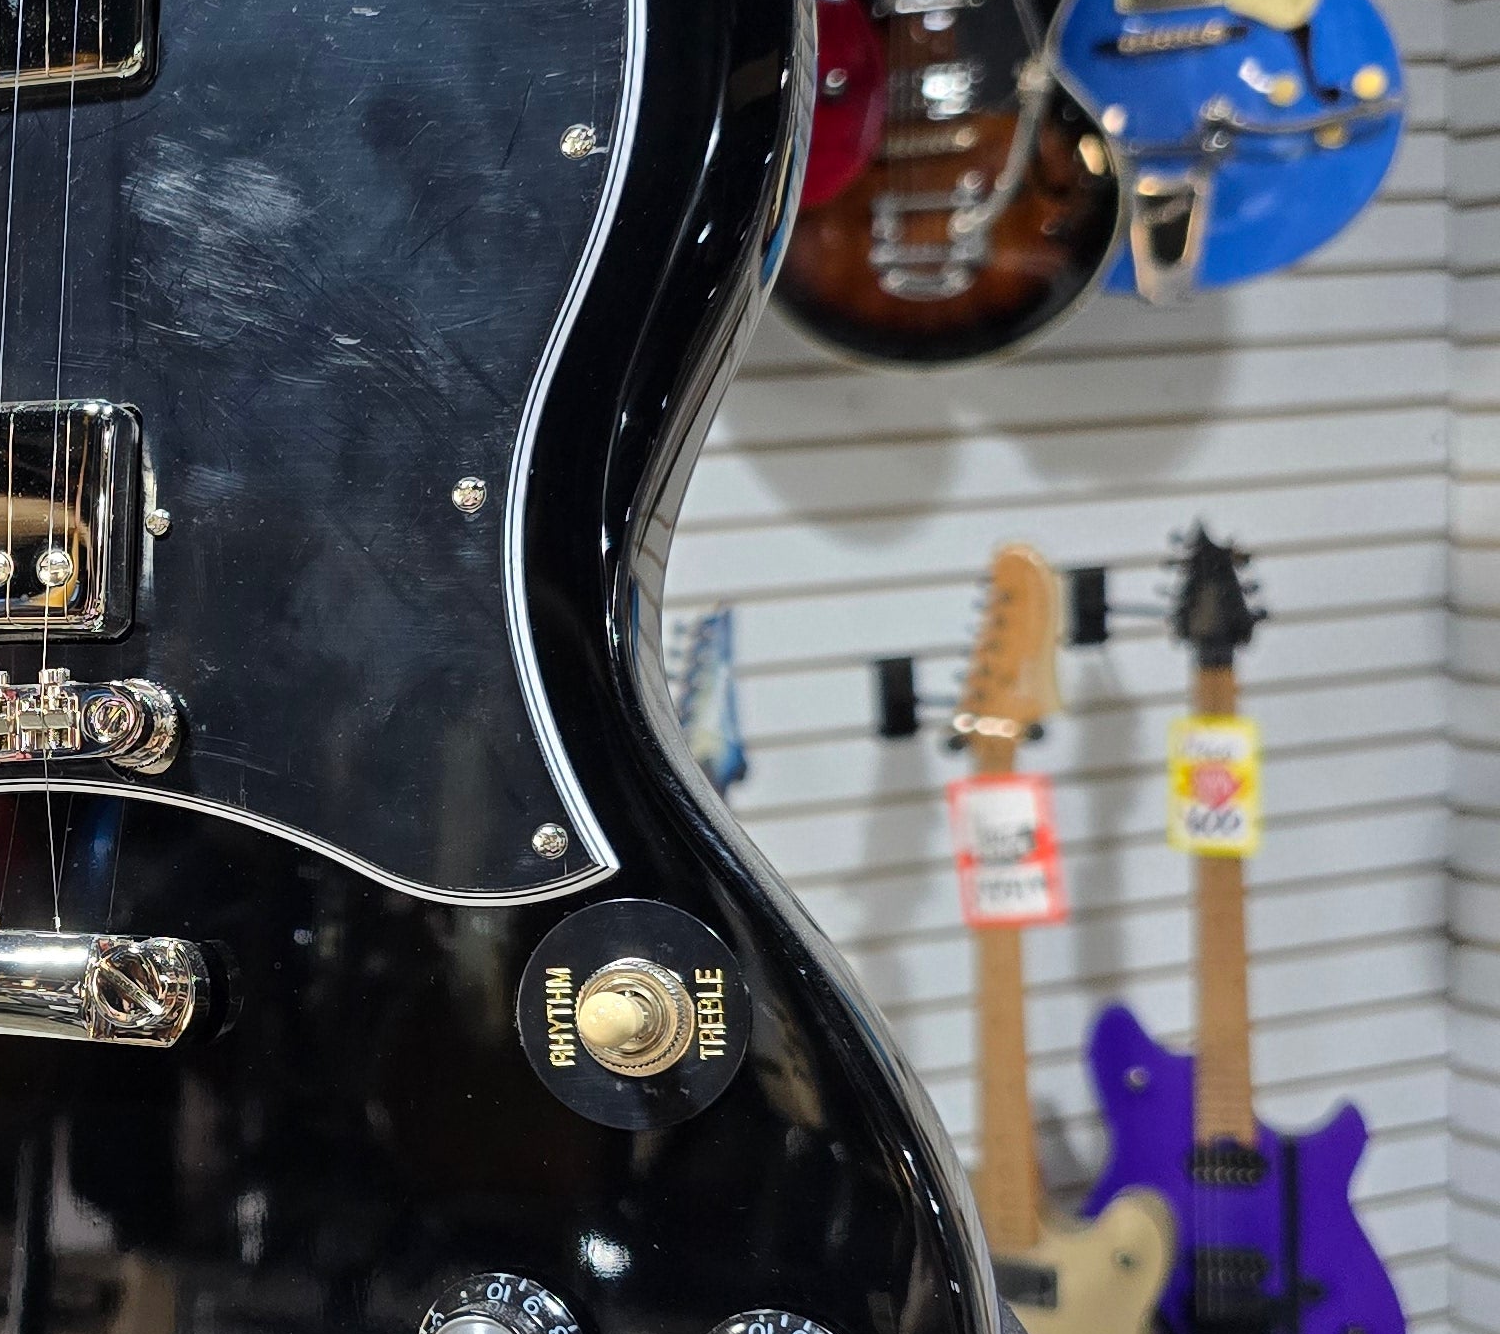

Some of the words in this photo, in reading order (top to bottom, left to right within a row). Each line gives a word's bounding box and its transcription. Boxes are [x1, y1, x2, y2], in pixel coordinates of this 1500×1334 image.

[545, 966, 577, 1067] RHYTHM
[695, 968, 727, 1061] TREBLE
[486, 1282, 512, 1302] 10
